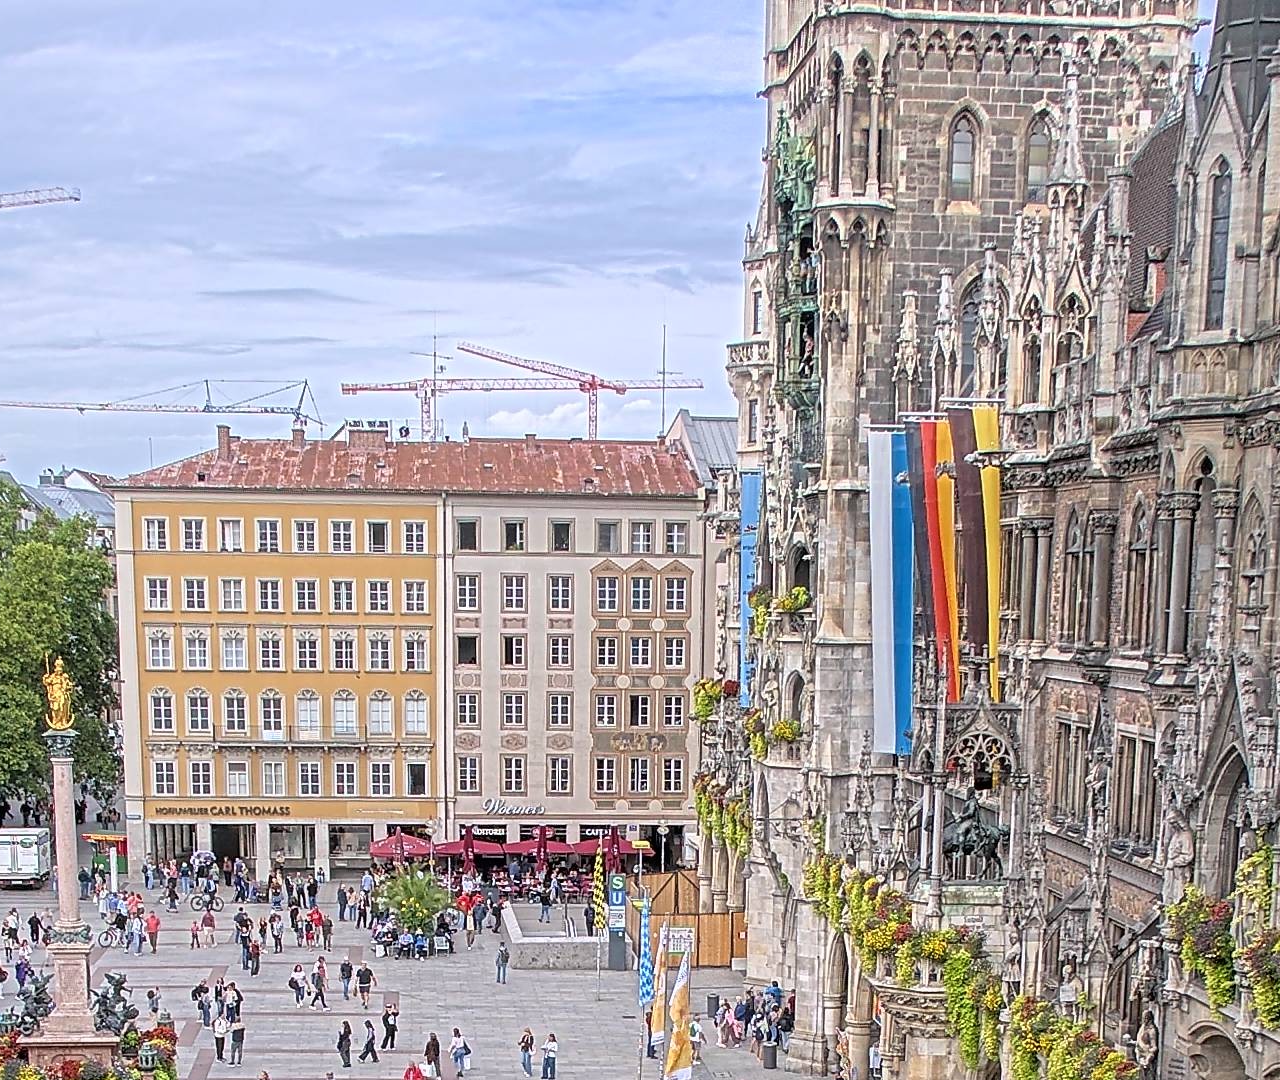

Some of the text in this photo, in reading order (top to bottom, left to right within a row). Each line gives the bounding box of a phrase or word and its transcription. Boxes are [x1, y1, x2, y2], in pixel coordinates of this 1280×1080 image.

[209, 806, 236, 816] CARL
[238, 806, 291, 816] THOMASS
[612, 876, 623, 889] S
[612, 893, 622, 904] U
